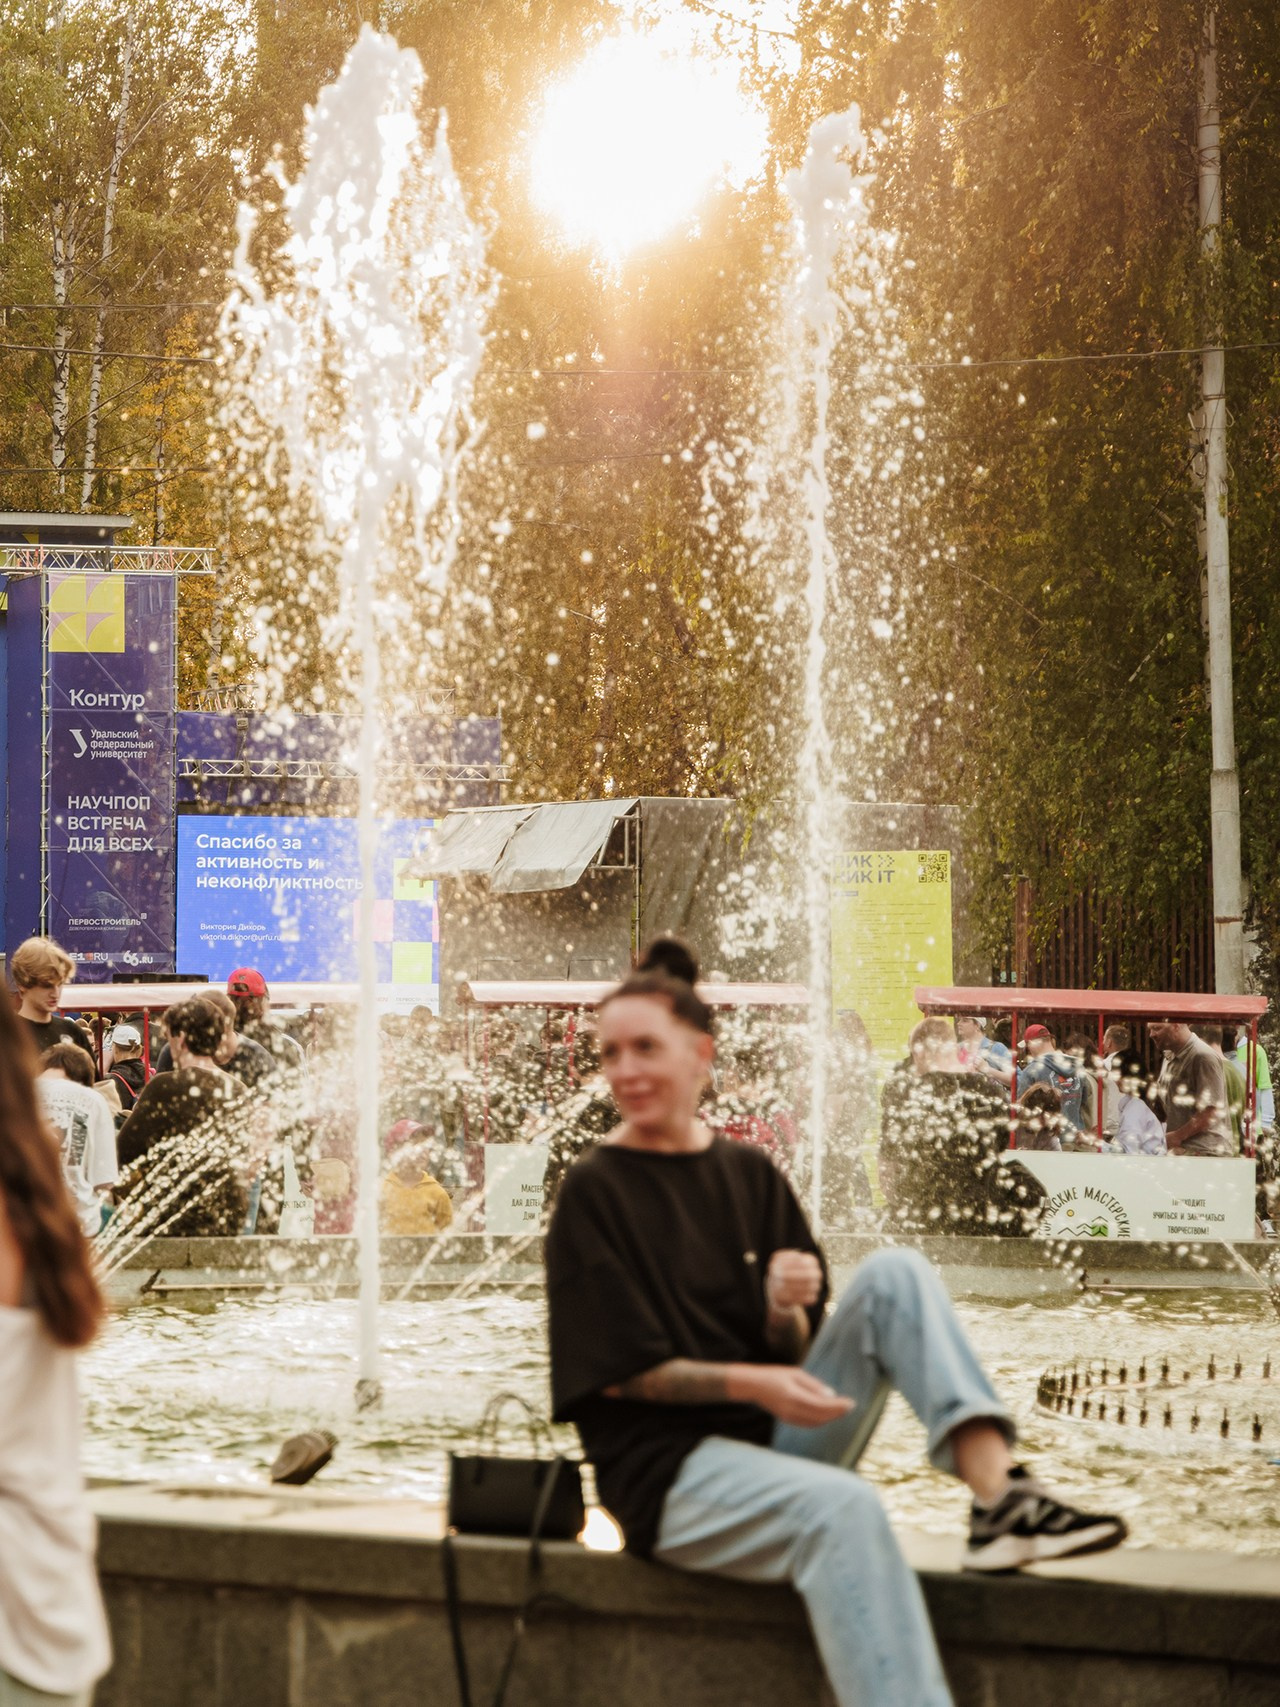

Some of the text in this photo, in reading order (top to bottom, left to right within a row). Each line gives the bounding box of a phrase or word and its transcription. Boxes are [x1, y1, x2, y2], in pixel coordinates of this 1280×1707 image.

[69, 688, 145, 710] Контур
[90, 729, 139, 739] Уральский
[90, 740, 154, 750] федеральный
[90, 750, 148, 760] университет
[68, 795, 151, 810] НАУЧПОП
[67, 816, 147, 831] ВСТРЕЧА
[67, 837, 154, 853] ДЛЯ ВСЕХ
[196, 833, 302, 850] Спасибо за
[196, 855, 303, 870] активность
[68, 918, 141, 926] ПЕРВОСТРОИТЕЛЬ
[1084, 1186, 1131, 1238] МАСТЕРСКИЕ
